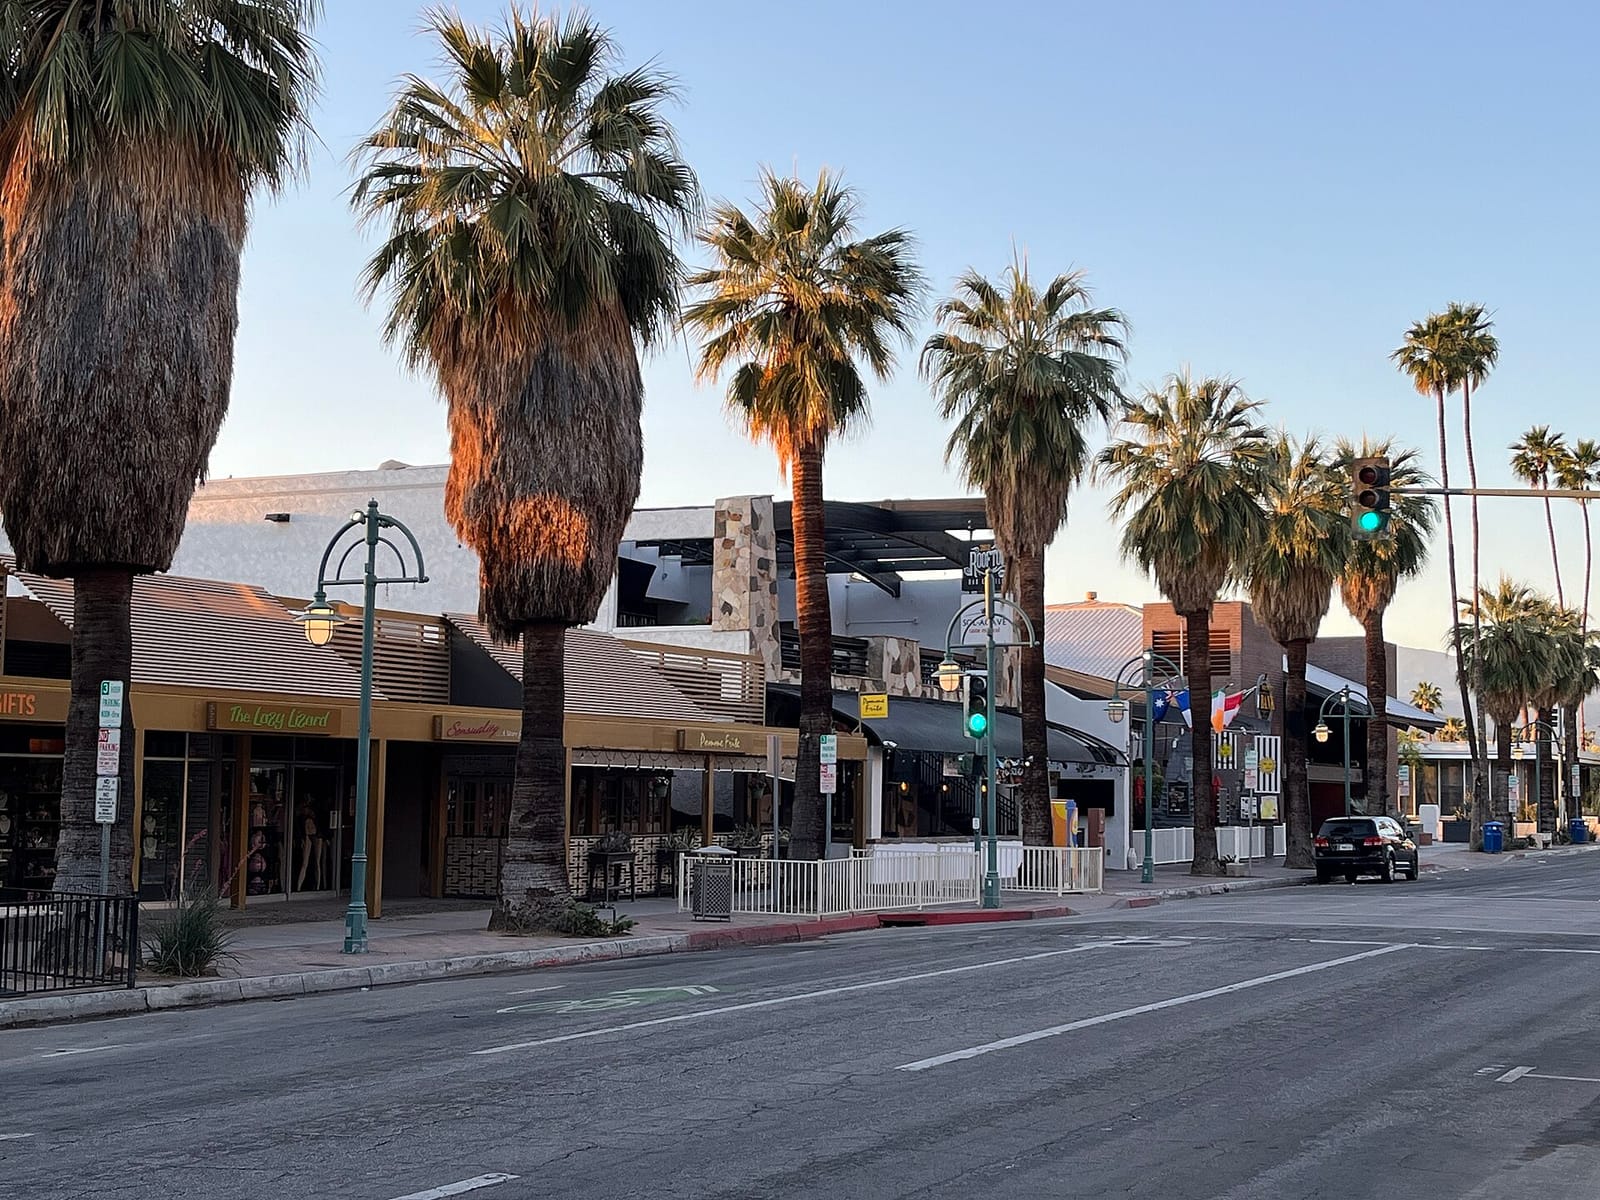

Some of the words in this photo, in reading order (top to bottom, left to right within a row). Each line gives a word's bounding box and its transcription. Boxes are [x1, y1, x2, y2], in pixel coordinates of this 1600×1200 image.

[964, 547, 1005, 577] ROOFTO
[102, 682, 109, 694] 3
[230, 705, 250, 723] The
[253, 706, 285, 729] Lazy
[288, 708, 330, 728] Lizard
[447, 720, 499, 739] Sensuality
